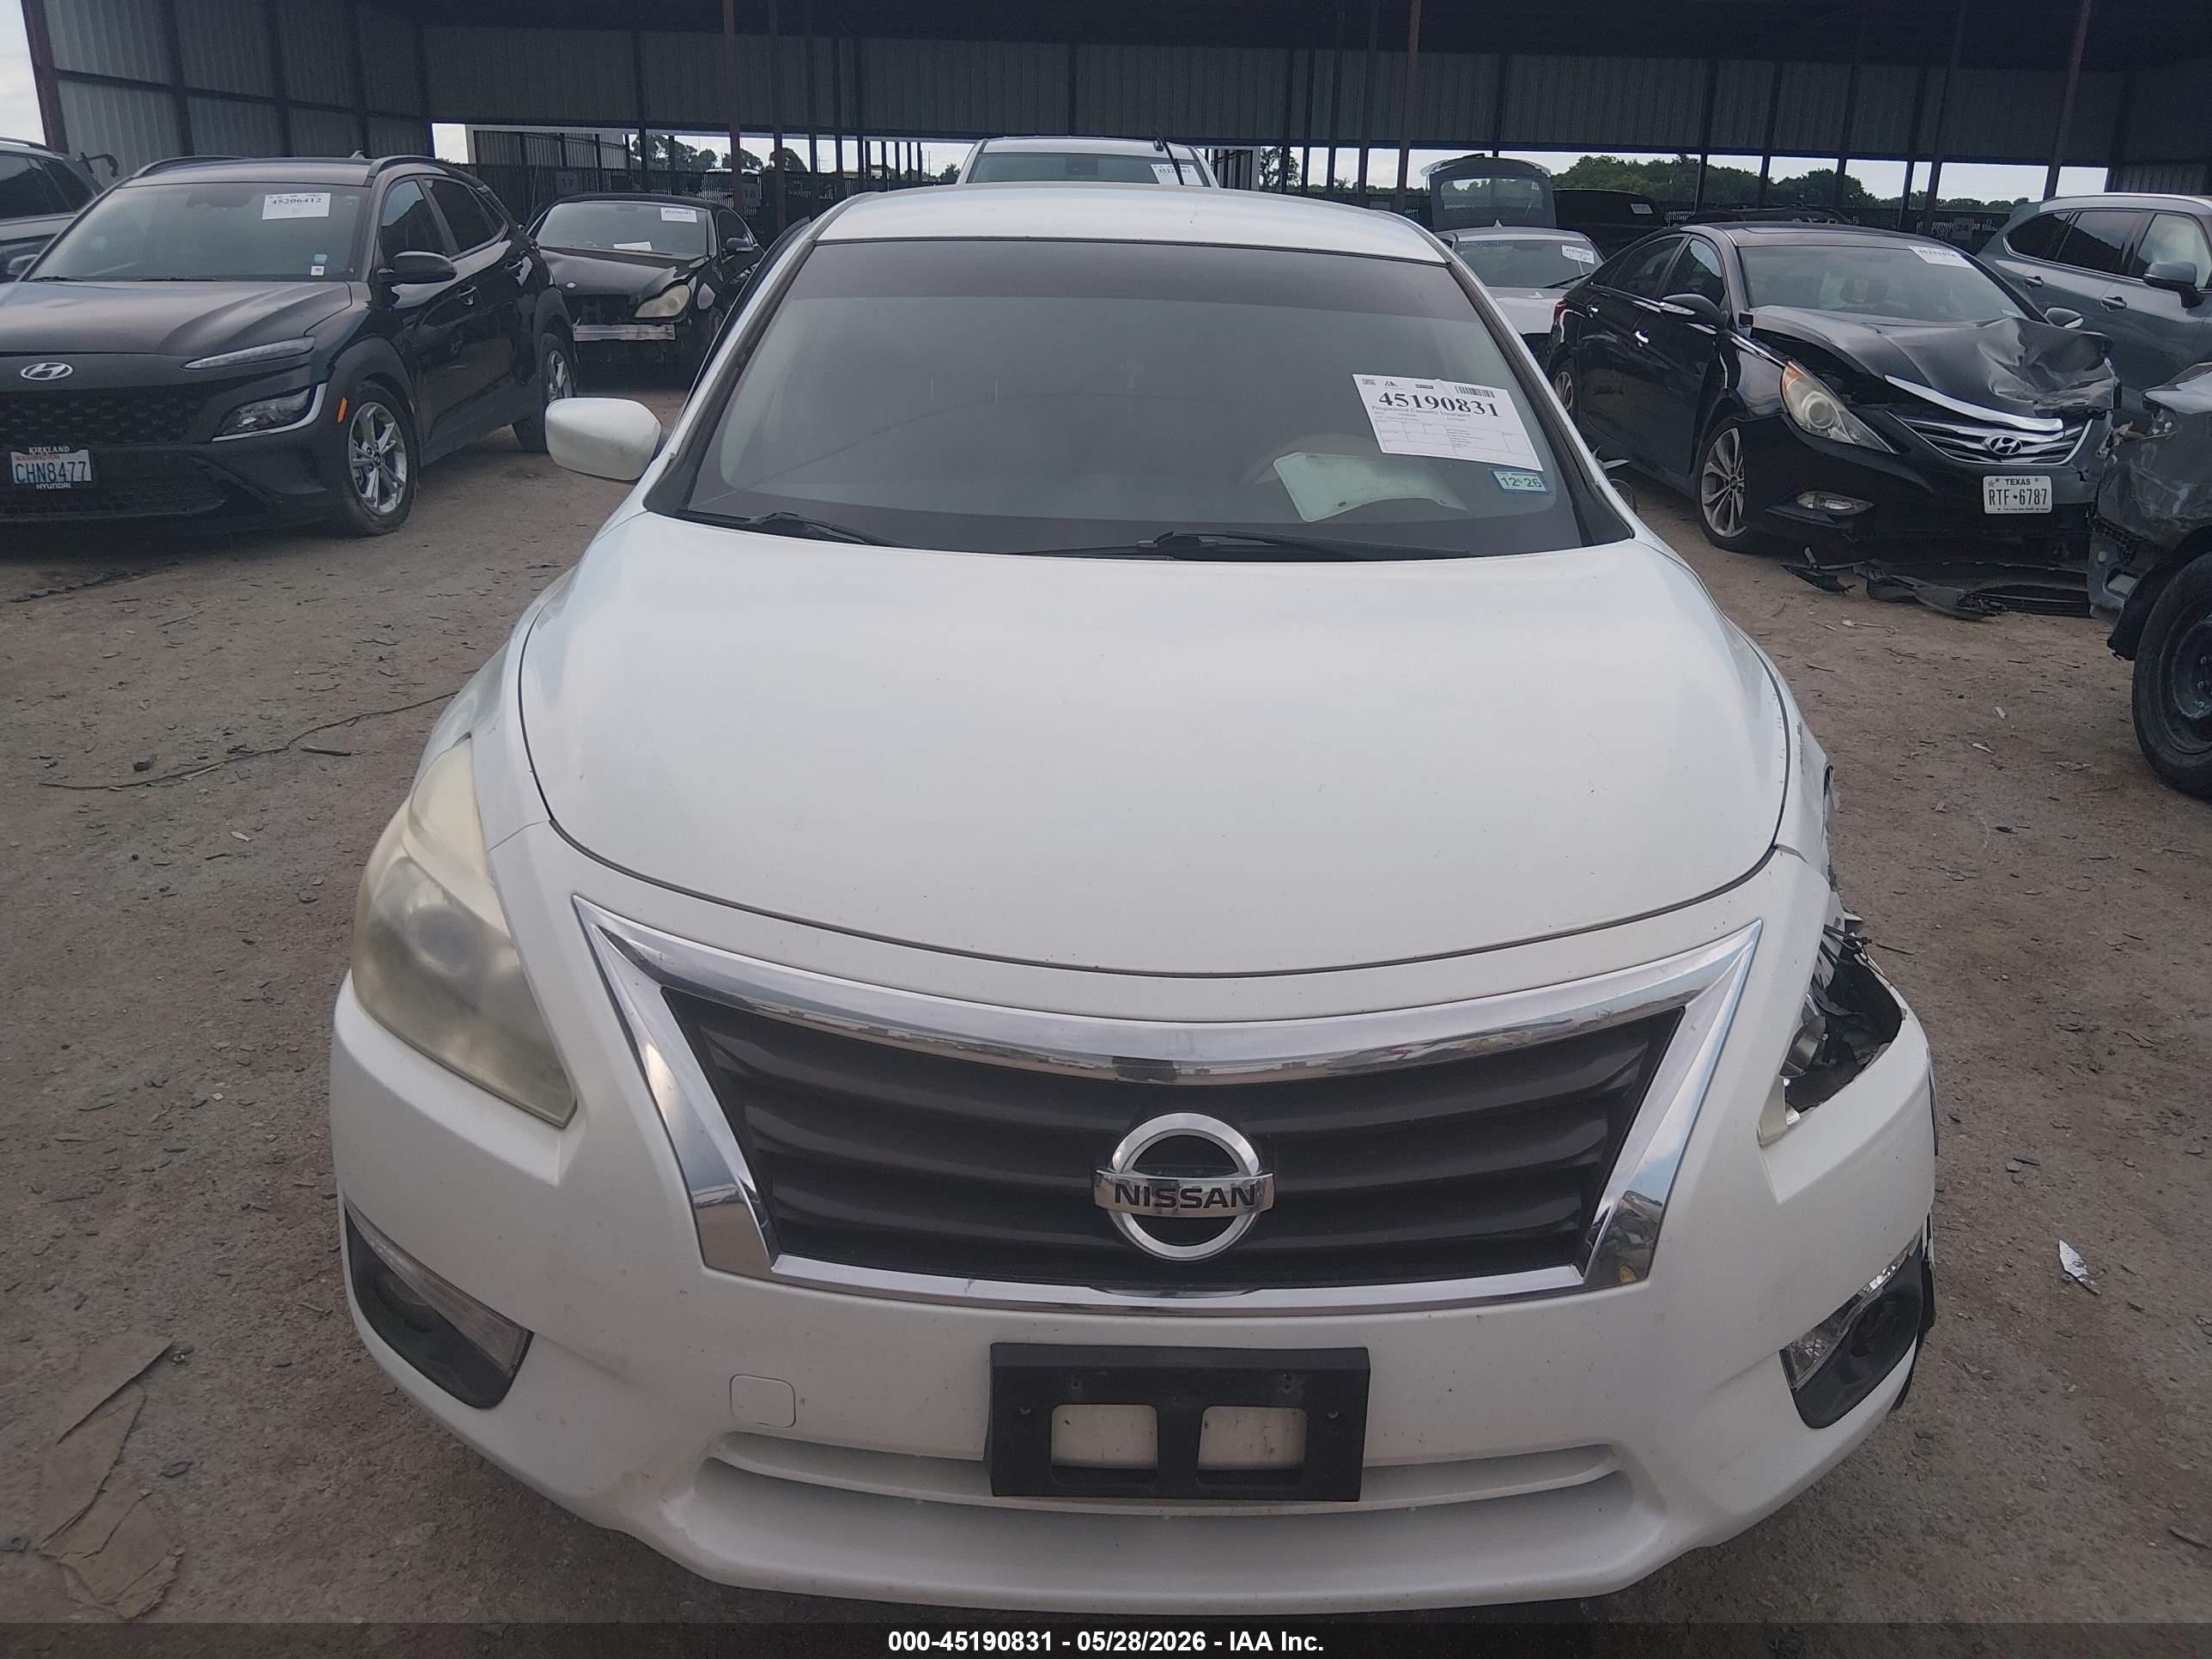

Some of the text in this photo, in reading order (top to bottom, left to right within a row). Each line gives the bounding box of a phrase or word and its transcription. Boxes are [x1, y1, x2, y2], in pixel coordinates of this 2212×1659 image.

[1378, 392, 1500, 418] 45190831
[28, 446, 70, 455] KIRKLAND
[15, 461, 87, 483] CHN8477
[1500, 477, 1542, 488] 12 26
[2005, 477, 2032, 486] TEXAS
[1115, 1182, 1257, 1210] NISSAN
